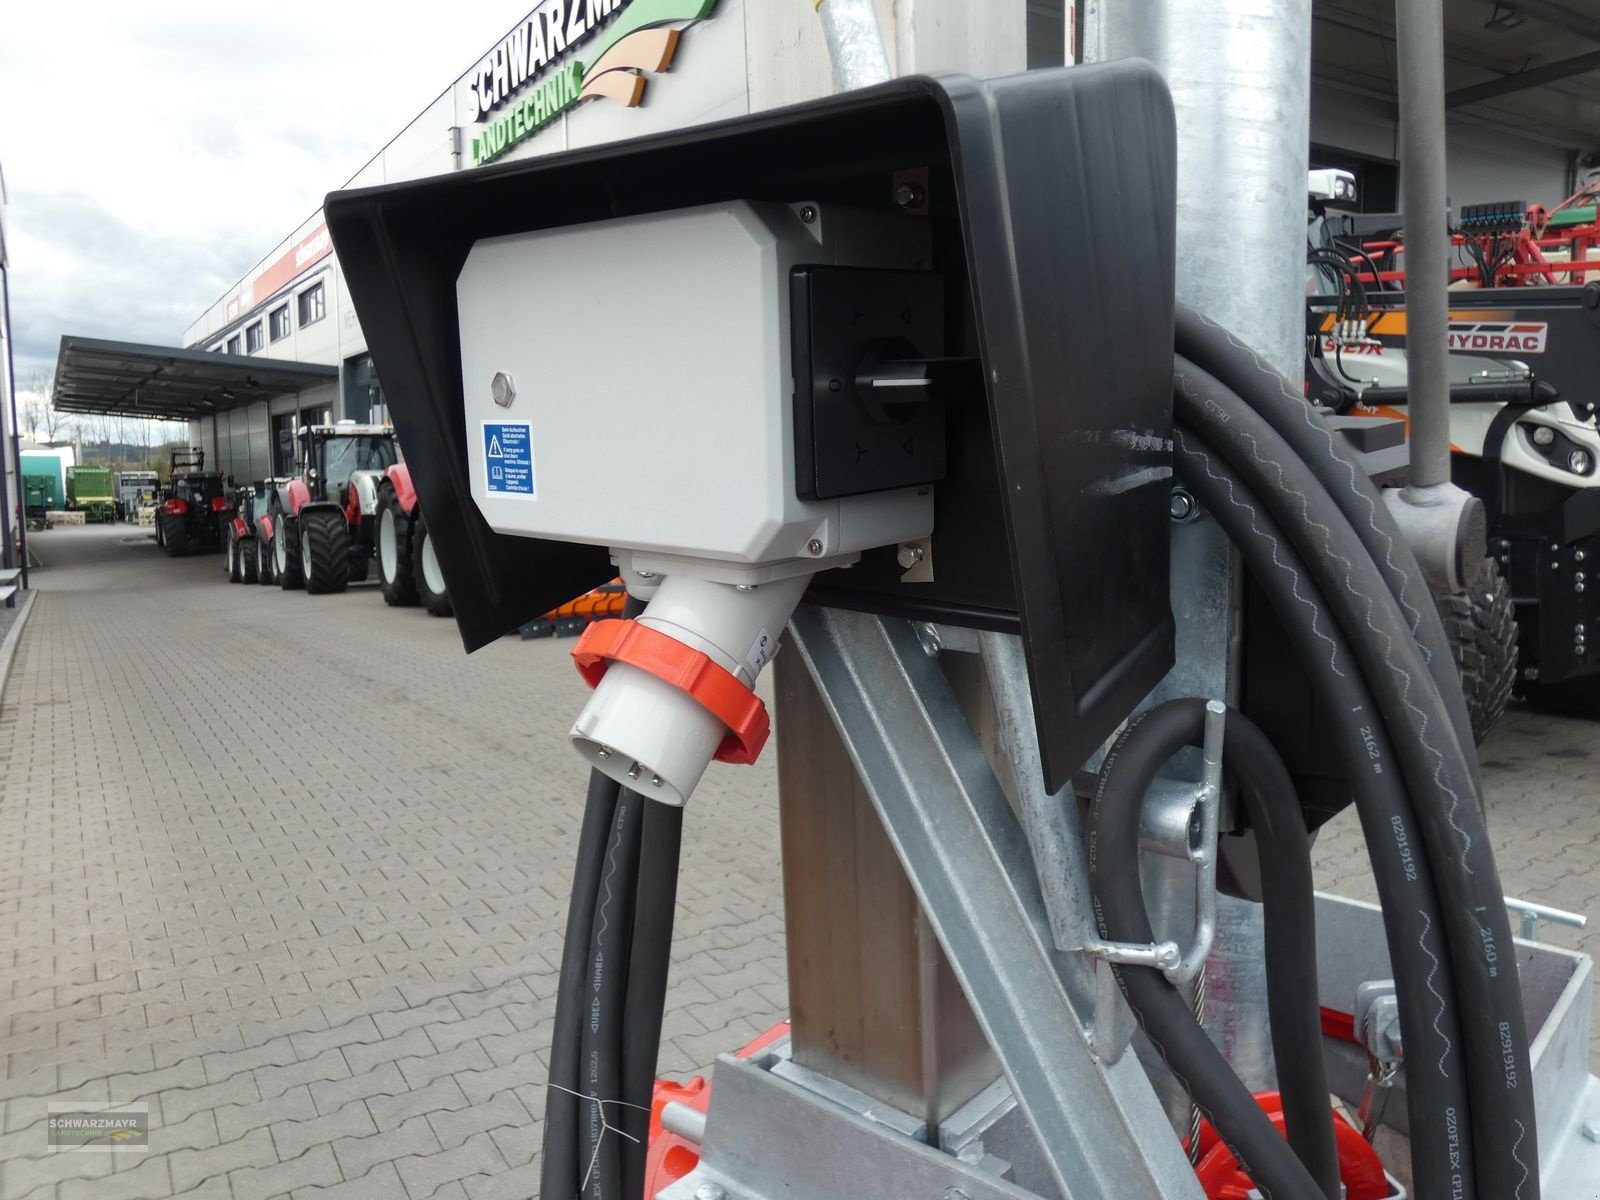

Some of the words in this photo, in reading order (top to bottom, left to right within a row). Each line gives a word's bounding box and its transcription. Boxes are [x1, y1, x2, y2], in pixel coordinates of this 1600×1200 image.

[471, 61, 583, 167] LANDTECHNIK
[1204, 399, 1231, 423] CT90
[1359, 726, 1380, 760] 2162
[1373, 763, 1382, 774] m
[1390, 815, 1418, 882] 82919192
[1480, 927, 1498, 963] 2160
[1488, 966, 1498, 977] m
[1498, 1021, 1518, 1090] 82919192
[1445, 1106, 1461, 1171] OZOFLEX
